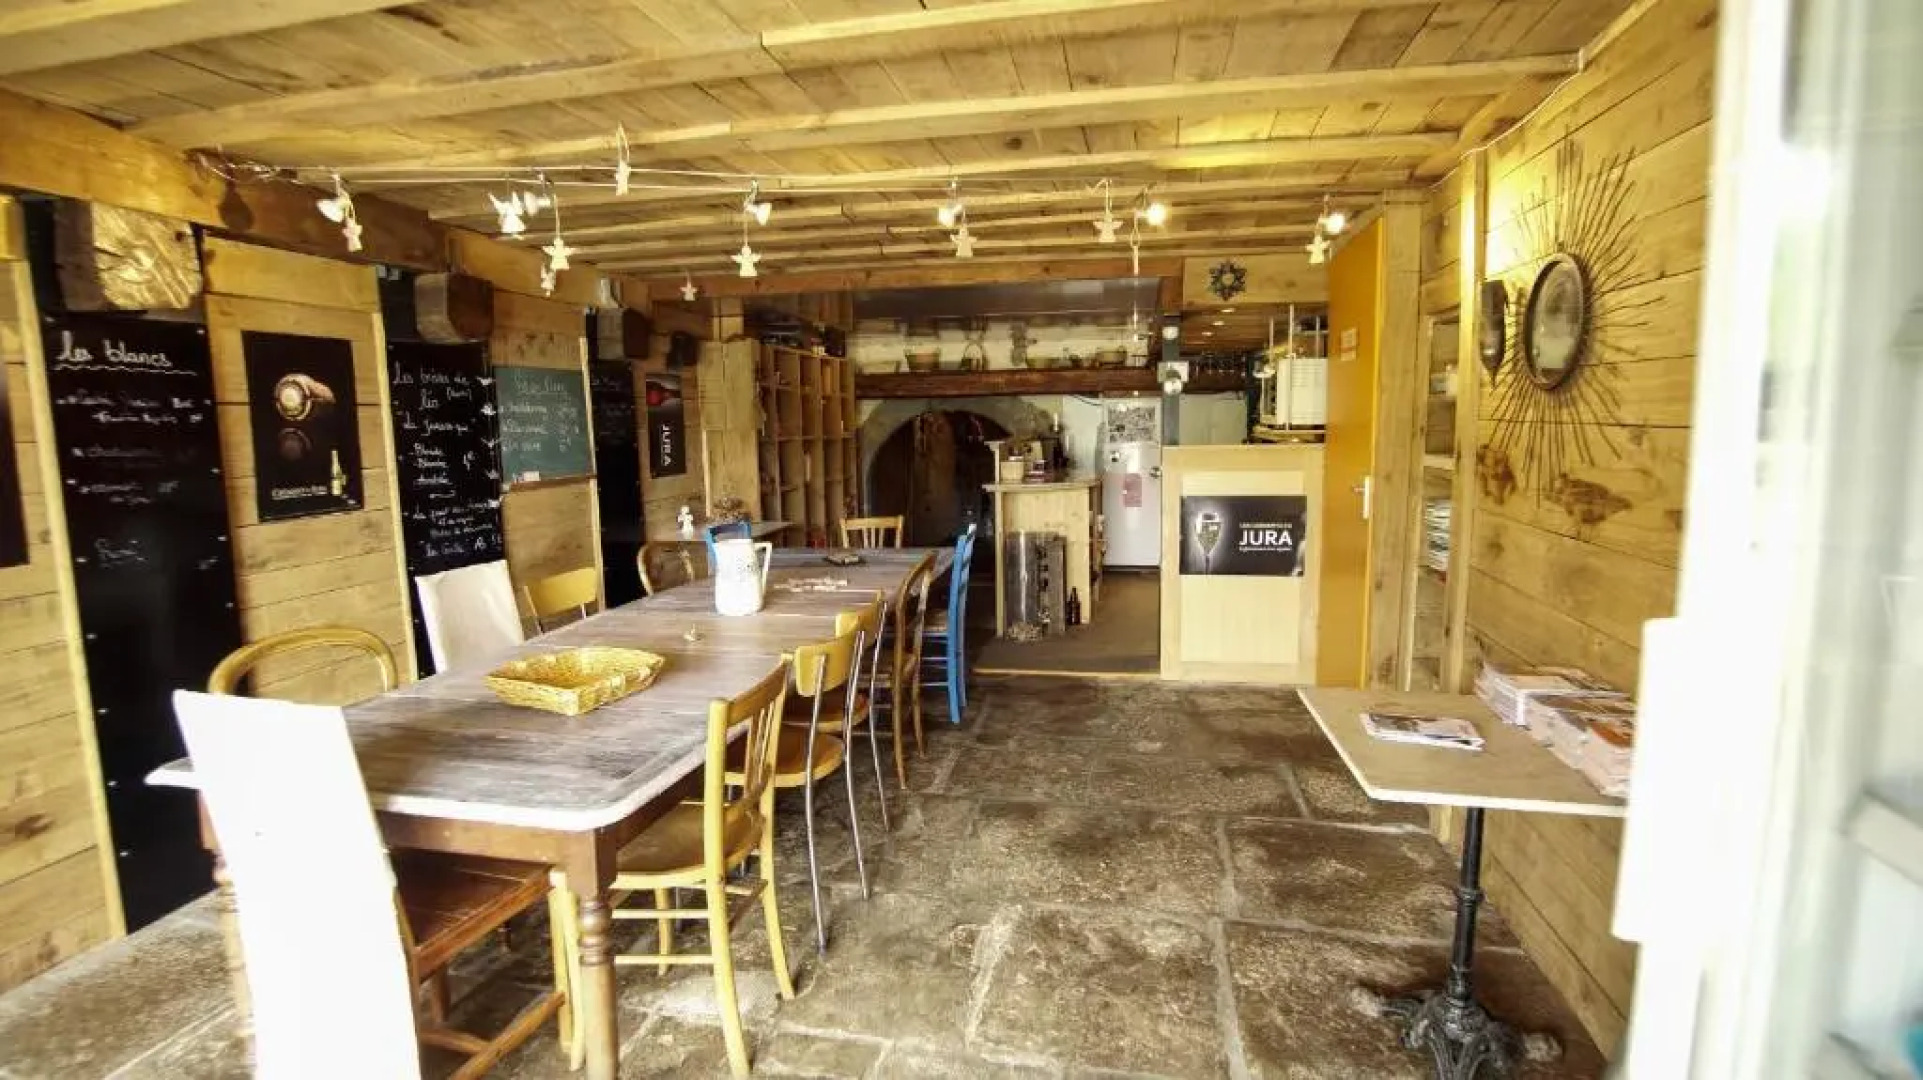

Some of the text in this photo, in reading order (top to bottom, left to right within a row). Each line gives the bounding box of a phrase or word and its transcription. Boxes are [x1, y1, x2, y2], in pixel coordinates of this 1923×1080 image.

[101, 338, 173, 368] blancs
[662, 423, 673, 467] JURA
[1239, 529, 1293, 546] JURA
